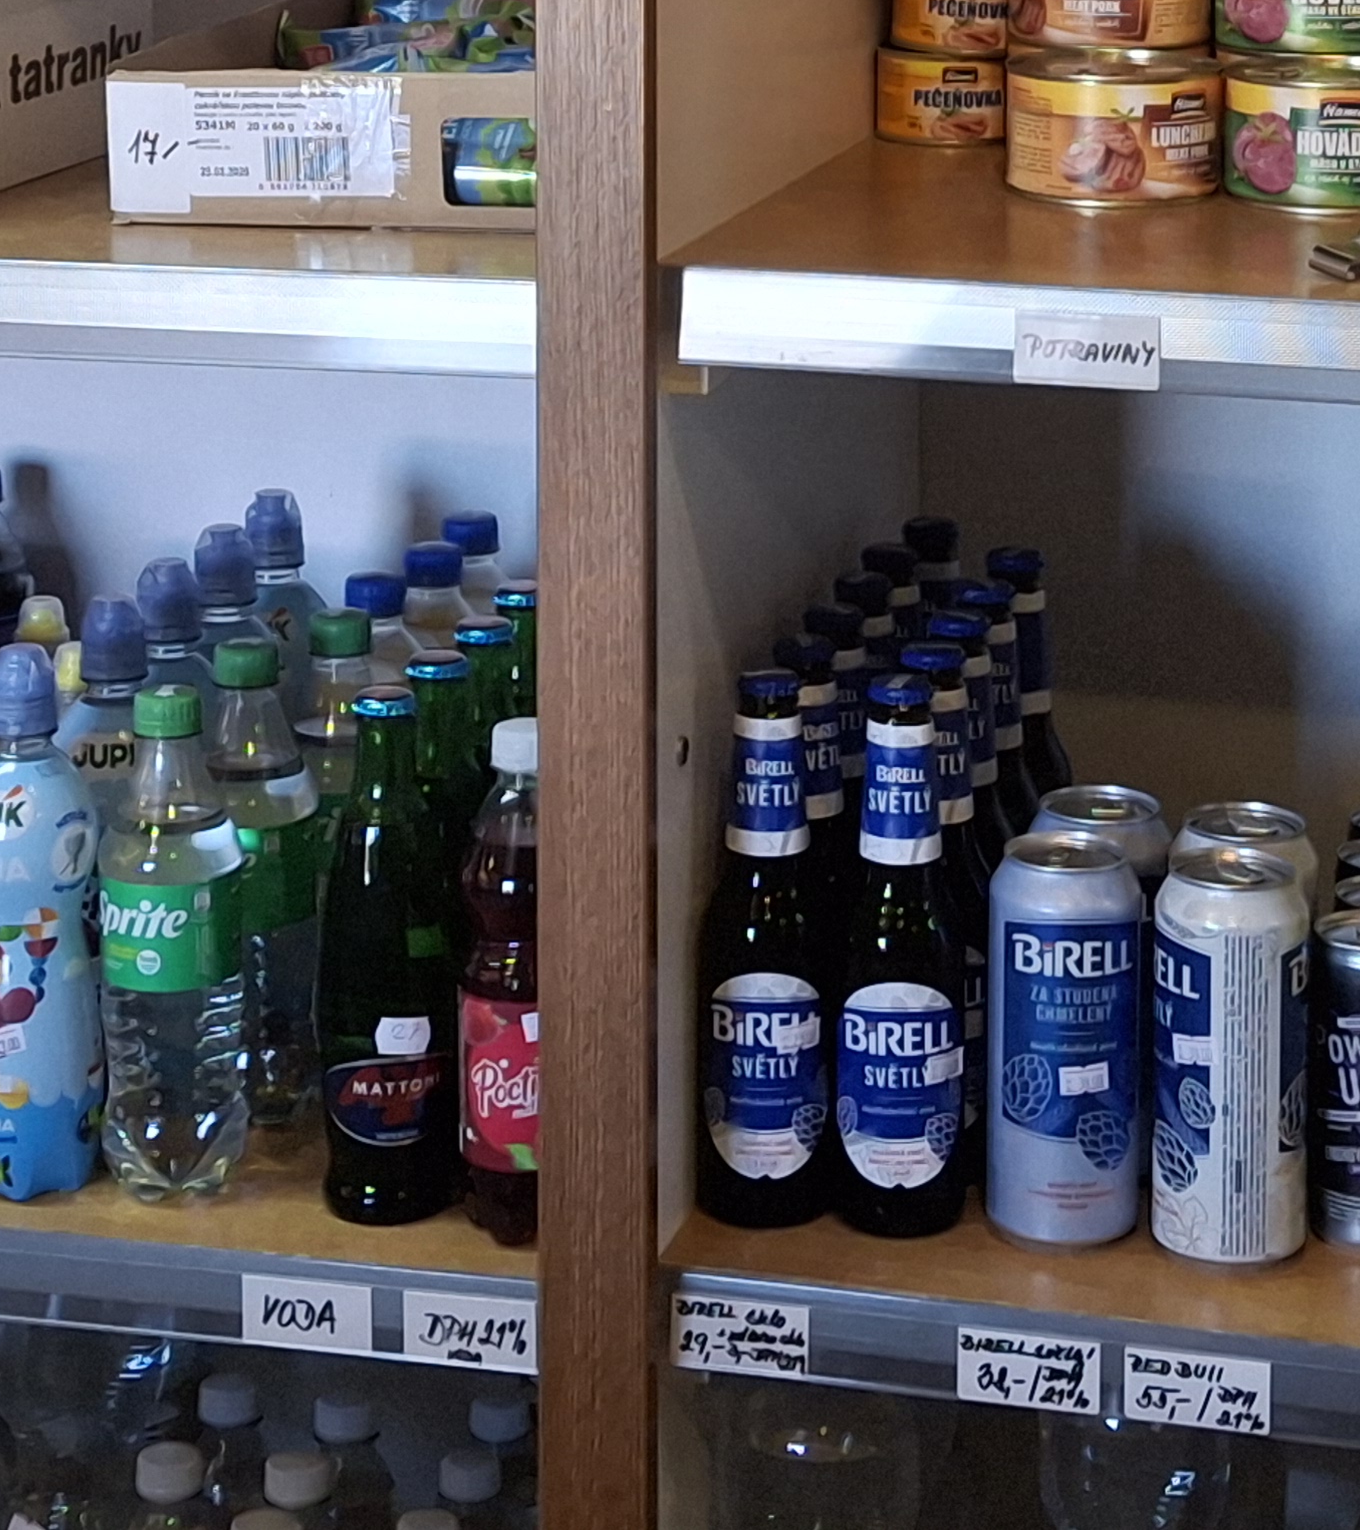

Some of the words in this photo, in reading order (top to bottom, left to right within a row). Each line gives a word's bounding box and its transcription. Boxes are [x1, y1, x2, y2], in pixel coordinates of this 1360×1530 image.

[1021, 333, 1157, 368] POTRAVINY
[744, 757, 795, 776] BiRELL
[875, 764, 926, 783] BiRELL
[97, 888, 189, 941] Sprite
[1011, 932, 1134, 979] BiRELL
[843, 1012, 955, 1057] BiRELL
[261, 1293, 337, 1336] VODA
[420, 1312, 478, 1348] DPH
[477, 1318, 527, 1356] 21%
